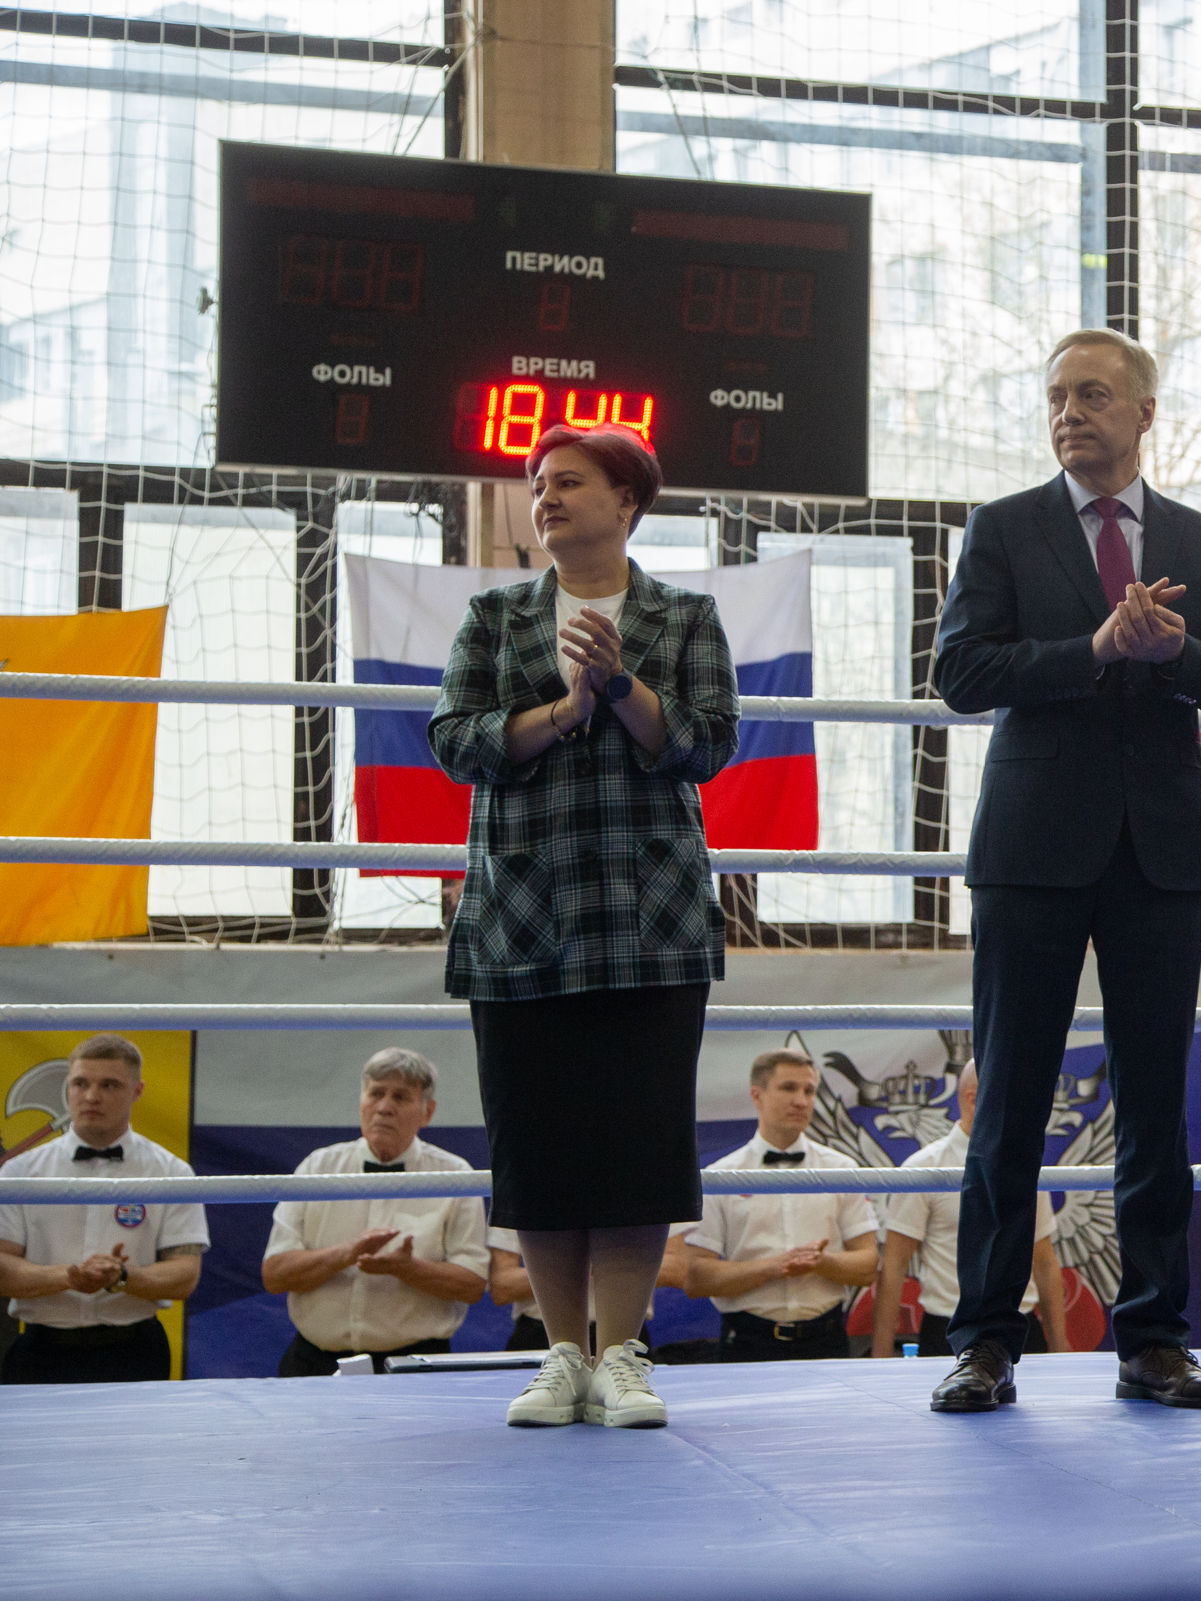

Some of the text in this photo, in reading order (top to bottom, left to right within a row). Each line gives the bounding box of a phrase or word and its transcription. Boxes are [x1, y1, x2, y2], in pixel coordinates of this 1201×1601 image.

[505, 250, 606, 280] ПЕРИОД
[311, 363, 392, 387] ФОЛЫ
[511, 355, 596, 380] ВРЕМЯ
[709, 388, 784, 412] ФОЛЫ
